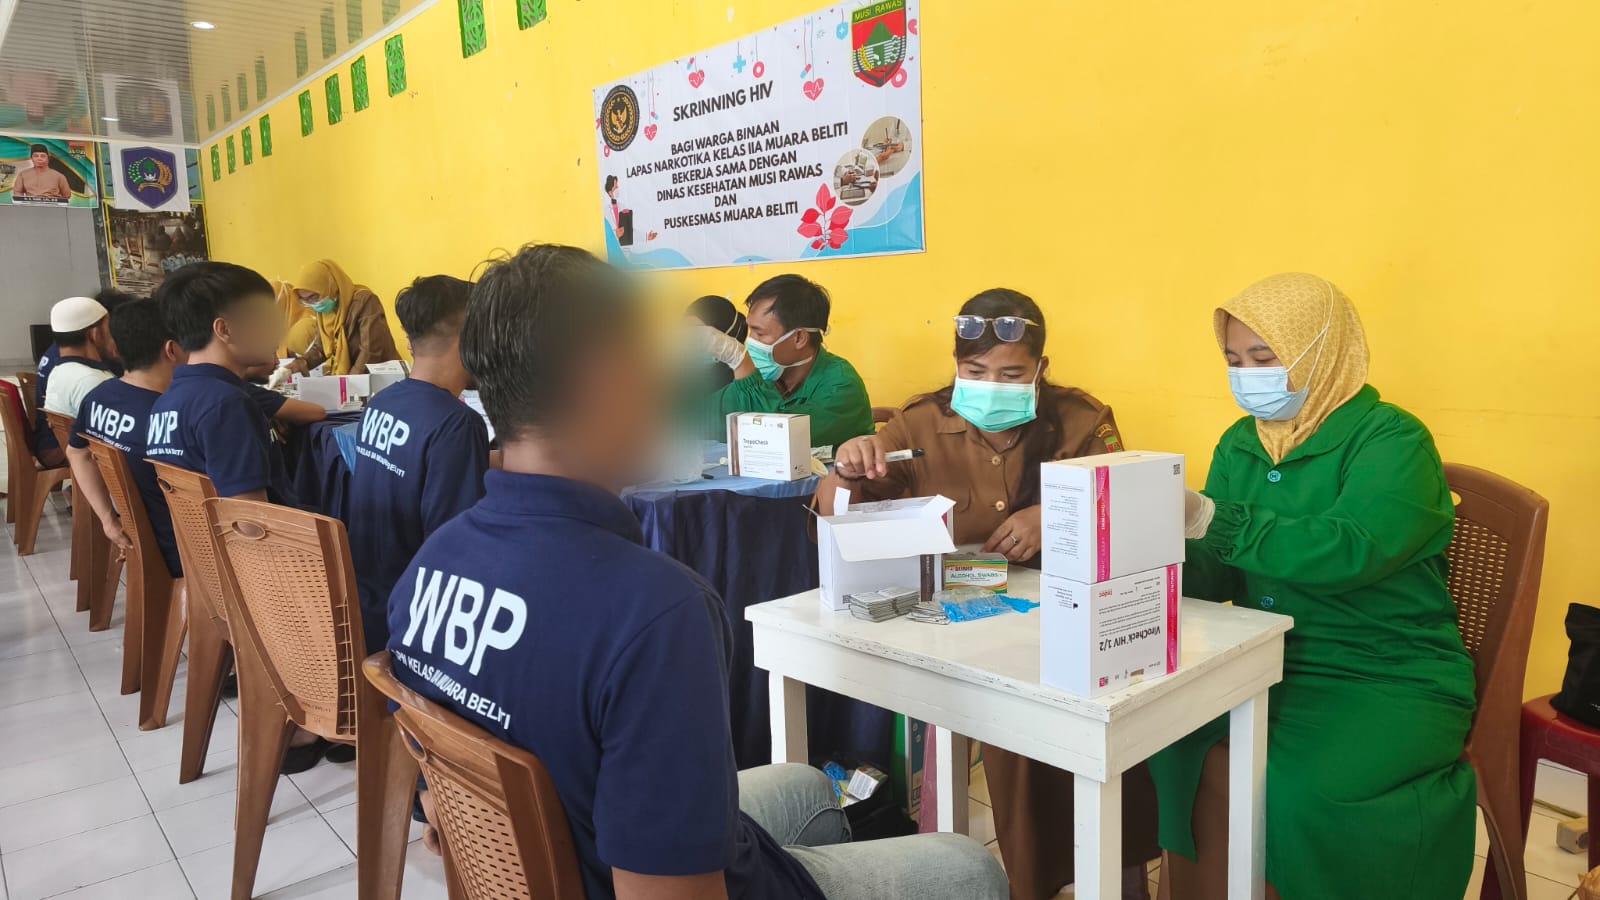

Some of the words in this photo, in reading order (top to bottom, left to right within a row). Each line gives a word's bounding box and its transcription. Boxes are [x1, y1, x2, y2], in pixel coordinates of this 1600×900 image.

[854, 9, 871, 20] MUSI
[875, 0, 902, 14] RAWAS
[673, 89, 746, 122] SKRINNING
[750, 80, 773, 103] HIV
[626, 163, 652, 178] LAPAS
[654, 151, 711, 173] NARKOTIKA
[713, 143, 746, 161] KELAS
[748, 141, 763, 154] IIA
[765, 130, 809, 151] MUARA
[811, 121, 848, 141] BELITI
[671, 140, 694, 155] BAGI
[695, 131, 735, 150] WARGA
[737, 120, 780, 141] BINAAN
[657, 186, 685, 202] DINAS
[687, 176, 746, 197] KESEHATAN
[749, 171, 776, 188] MUSI
[779, 163, 823, 183] RAWAS
[672, 166, 714, 184] BEKERJA
[715, 160, 747, 177] SAMA
[749, 150, 797, 171] DENGAN
[664, 211, 721, 229] PUSKESMAS
[723, 206, 763, 222] MUARA
[766, 201, 798, 217] BELITI
[714, 193, 737, 207] DAN
[90, 401, 136, 439] WBP
[361, 407, 410, 455] WBP
[402, 566, 527, 676] WBP
[1128, 625, 1160, 643] ViroCheck
[1099, 639, 1112, 652] 1/2
[1113, 635, 1126, 647] HIV
[407, 655, 434, 681] KELAS
